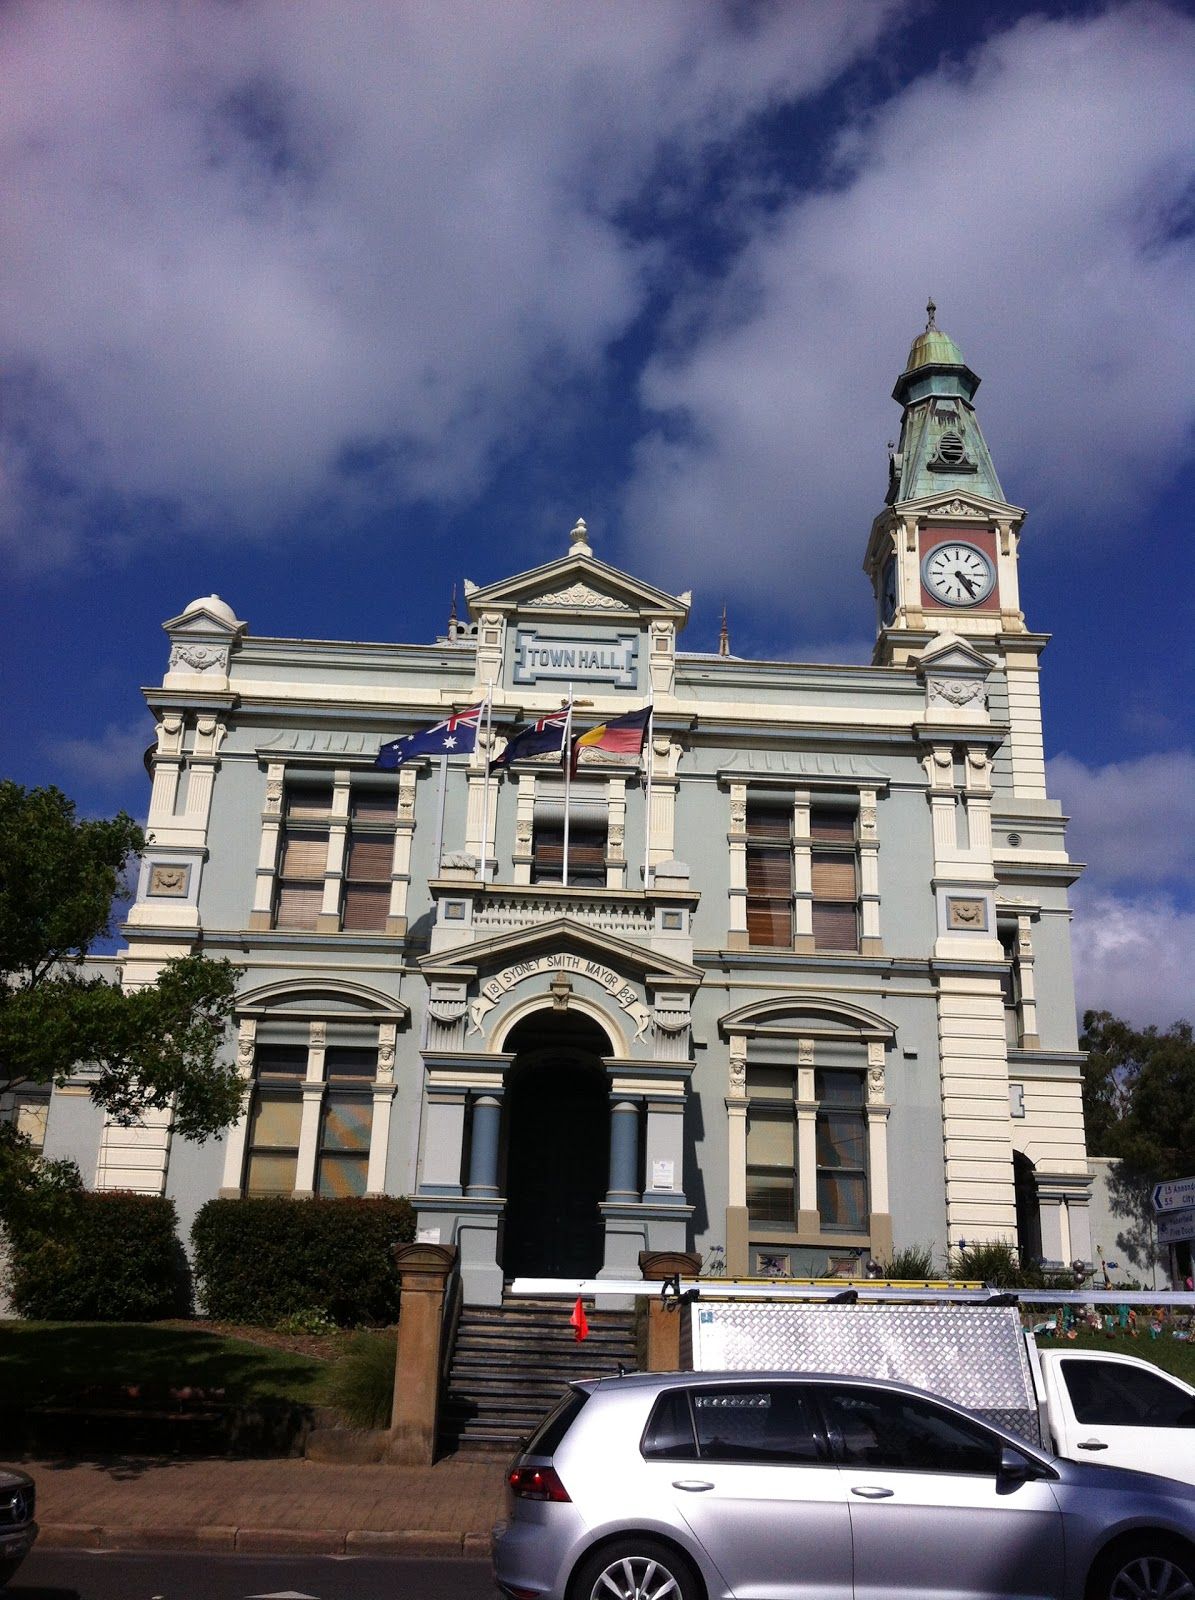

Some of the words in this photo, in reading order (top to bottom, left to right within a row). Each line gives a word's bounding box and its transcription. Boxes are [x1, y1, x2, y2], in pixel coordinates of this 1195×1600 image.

[528, 649, 575, 668] TOWN
[487, 983, 500, 996] 18
[503, 960, 540, 983] SYDNEY
[547, 956, 581, 969] SMITH
[585, 962, 619, 987] MAYOR
[619, 988, 636, 1004] 88
